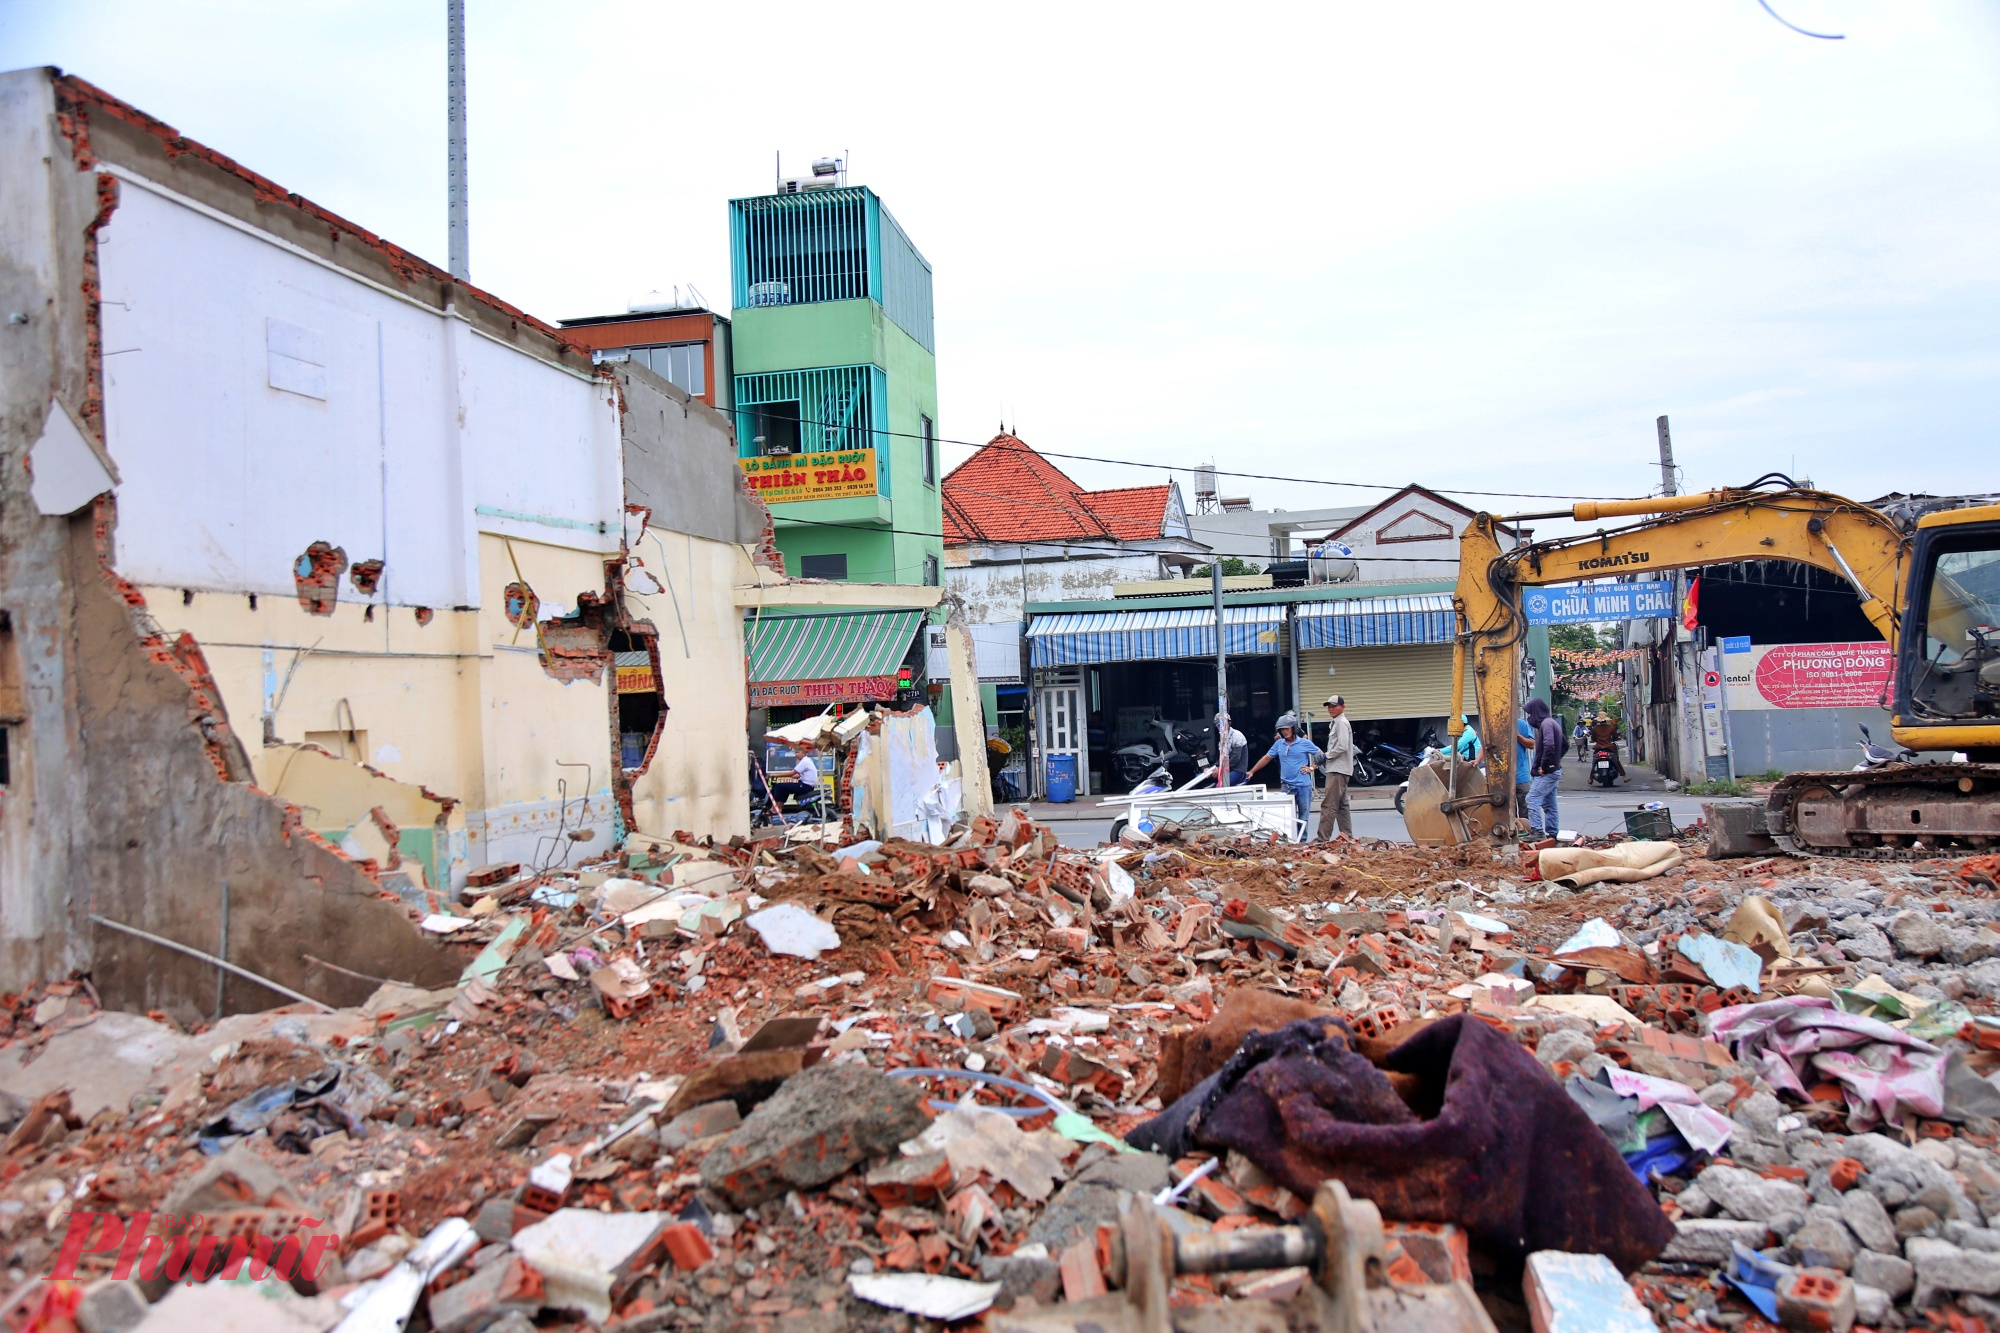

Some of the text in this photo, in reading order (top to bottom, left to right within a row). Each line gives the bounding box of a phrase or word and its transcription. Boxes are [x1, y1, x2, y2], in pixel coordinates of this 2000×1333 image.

[746, 451, 866, 471] LÒ BÁNH MÌ ĐẶC RUỘT
[748, 463, 866, 489] THIÊN THẢO
[1578, 551, 1650, 570] KOMATSU
[1630, 583, 1644, 592] VIỆT
[1552, 593, 1589, 617] CHÙA
[1636, 589, 1673, 612] CHÂU
[1783, 655, 1885, 670] PHƯƠNG ĐÔNG
[1816, 649, 1836, 657] CÔNG
[762, 684, 778, 698] ĐẶC
[780, 682, 801, 697] RUỘT
[803, 680, 844, 697] THIÊN
[849, 677, 887, 696] THẢO
